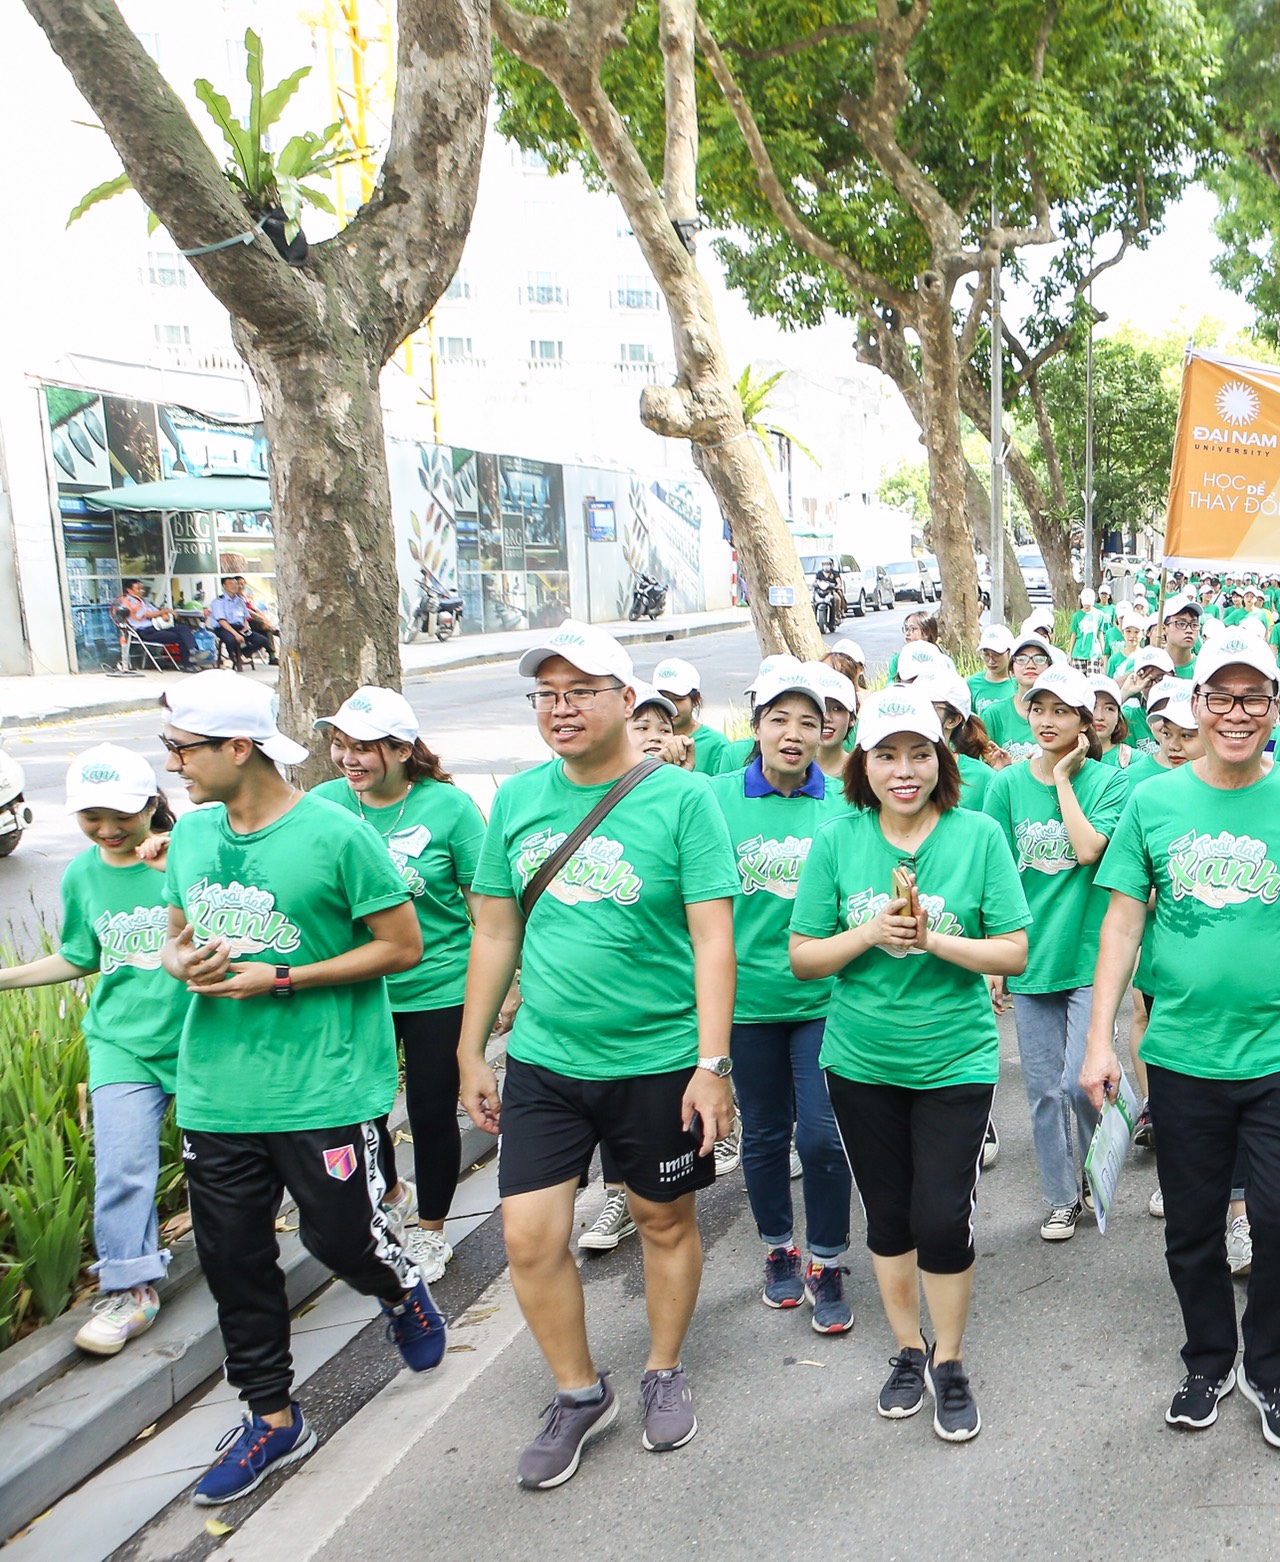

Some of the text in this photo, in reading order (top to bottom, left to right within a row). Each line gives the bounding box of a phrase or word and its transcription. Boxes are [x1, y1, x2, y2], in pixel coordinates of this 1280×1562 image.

[1192, 426, 1278, 448] ĐẠI NAM
[1194, 444, 1271, 457] UNIVERSITY
[1203, 472, 1266, 496] HỌC ĐỂ
[1188, 491, 1239, 512] THAY
[173, 513, 212, 537] BRG
[175, 542, 213, 555] GROUP
[1017, 836, 1077, 871] Xan
